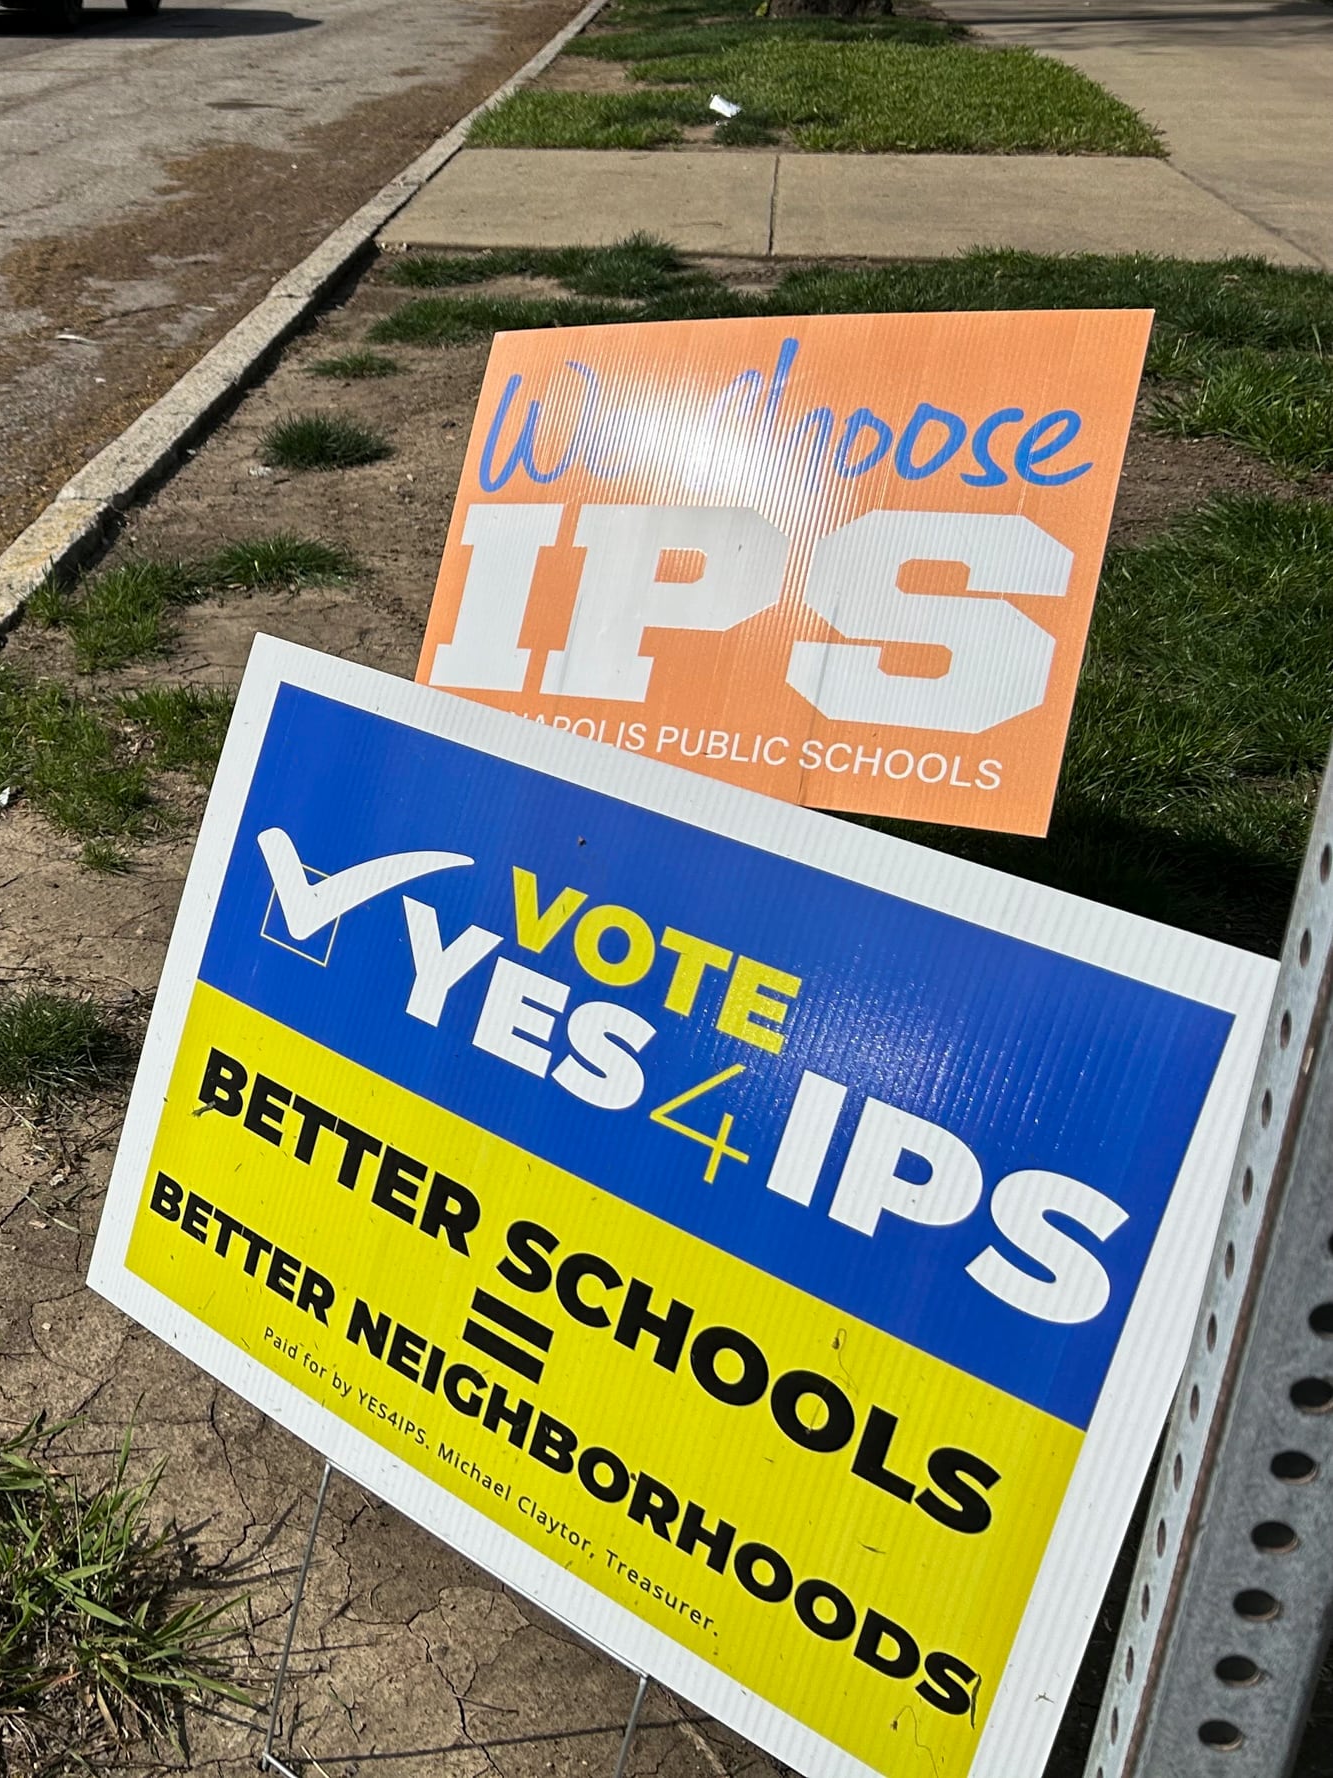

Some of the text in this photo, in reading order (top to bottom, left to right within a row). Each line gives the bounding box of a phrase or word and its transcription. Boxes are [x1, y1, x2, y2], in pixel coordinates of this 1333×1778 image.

[430, 502, 1074, 734] IPS
[655, 725, 790, 766] PUBLIC
[798, 739, 1003, 791] SCHOOLS
[512, 865, 802, 1055] VOTE
[197, 1047, 1003, 1535] BETTER SCHOOLS
[149, 1170, 978, 1716] BETTER NEIGHBORHOODS
[263, 1325, 720, 1638] Paid for by YES4IPS. Michael Claytor, Treasurer.
